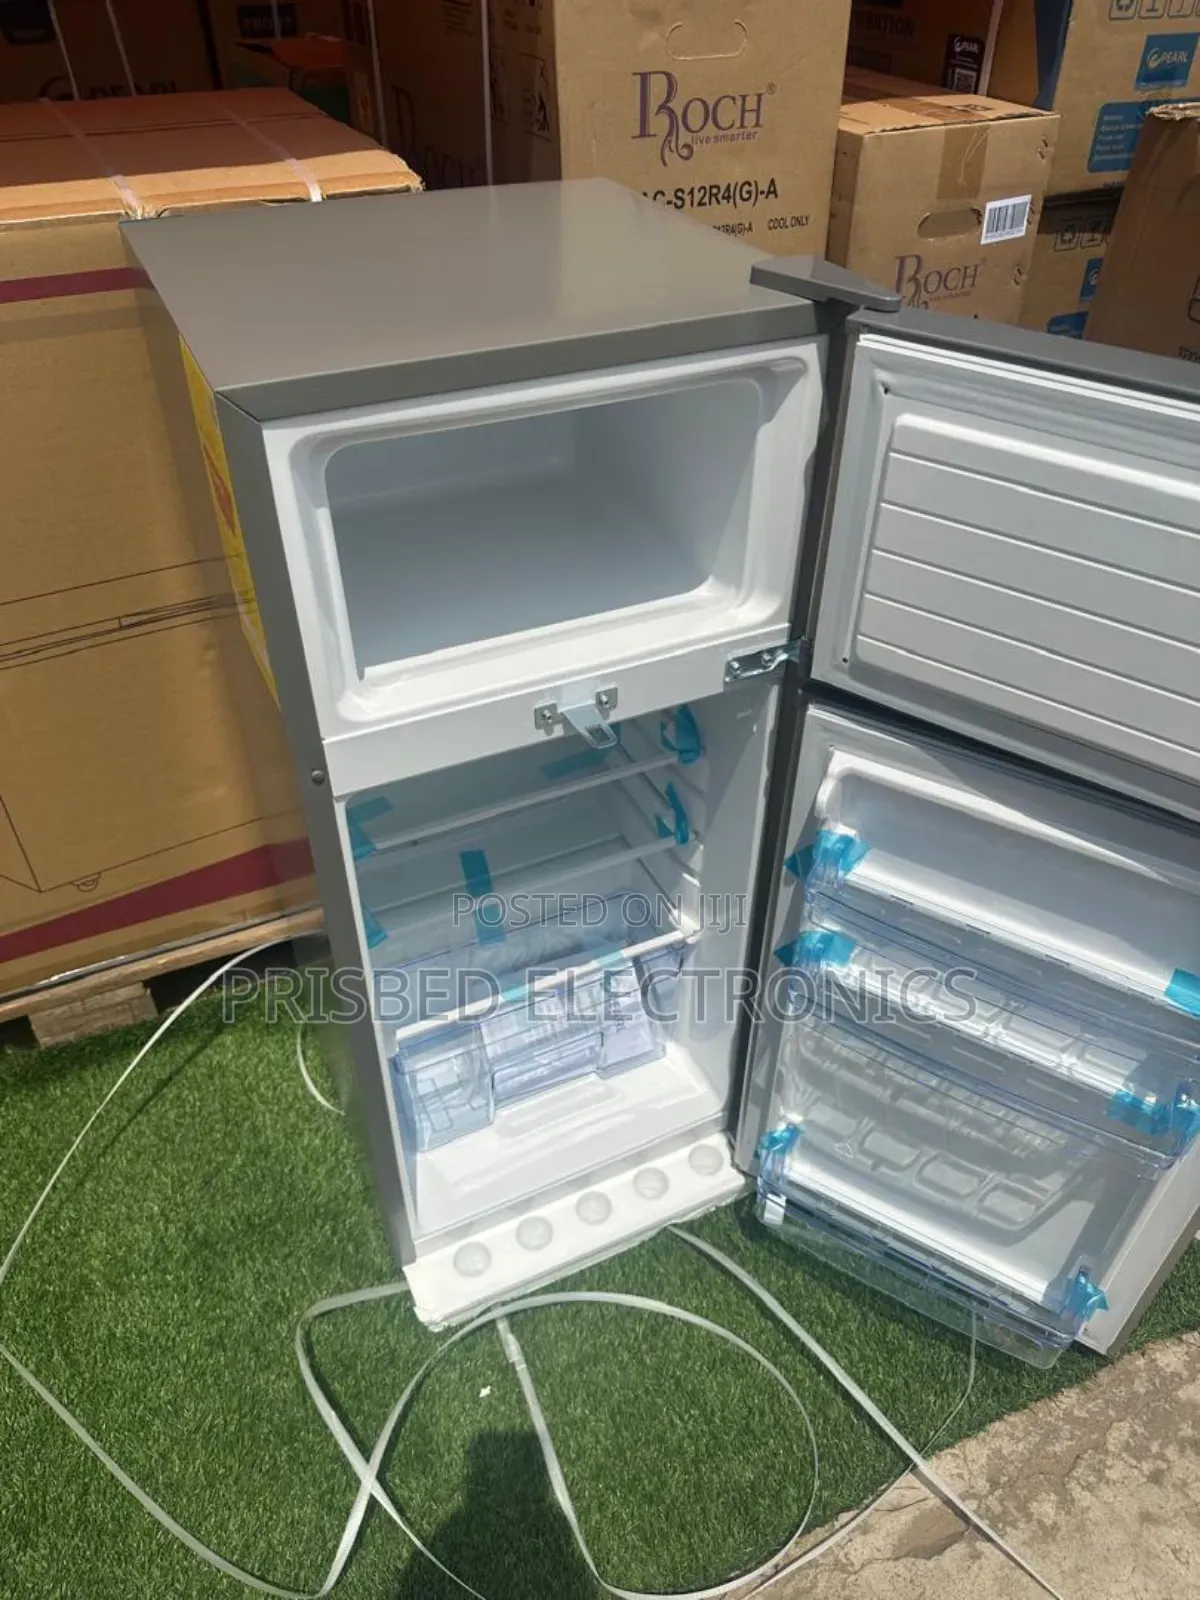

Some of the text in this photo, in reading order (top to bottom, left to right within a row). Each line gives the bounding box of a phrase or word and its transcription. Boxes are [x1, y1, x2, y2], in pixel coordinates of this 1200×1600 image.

[631, 70, 764, 166] ROCH
[713, 131, 759, 144] smarter
[643, 177, 779, 210] -S12R4(G)-A
[768, 217, 789, 231] COOL
[790, 215, 811, 228] ONLY
[894, 254, 979, 309] ROCH
